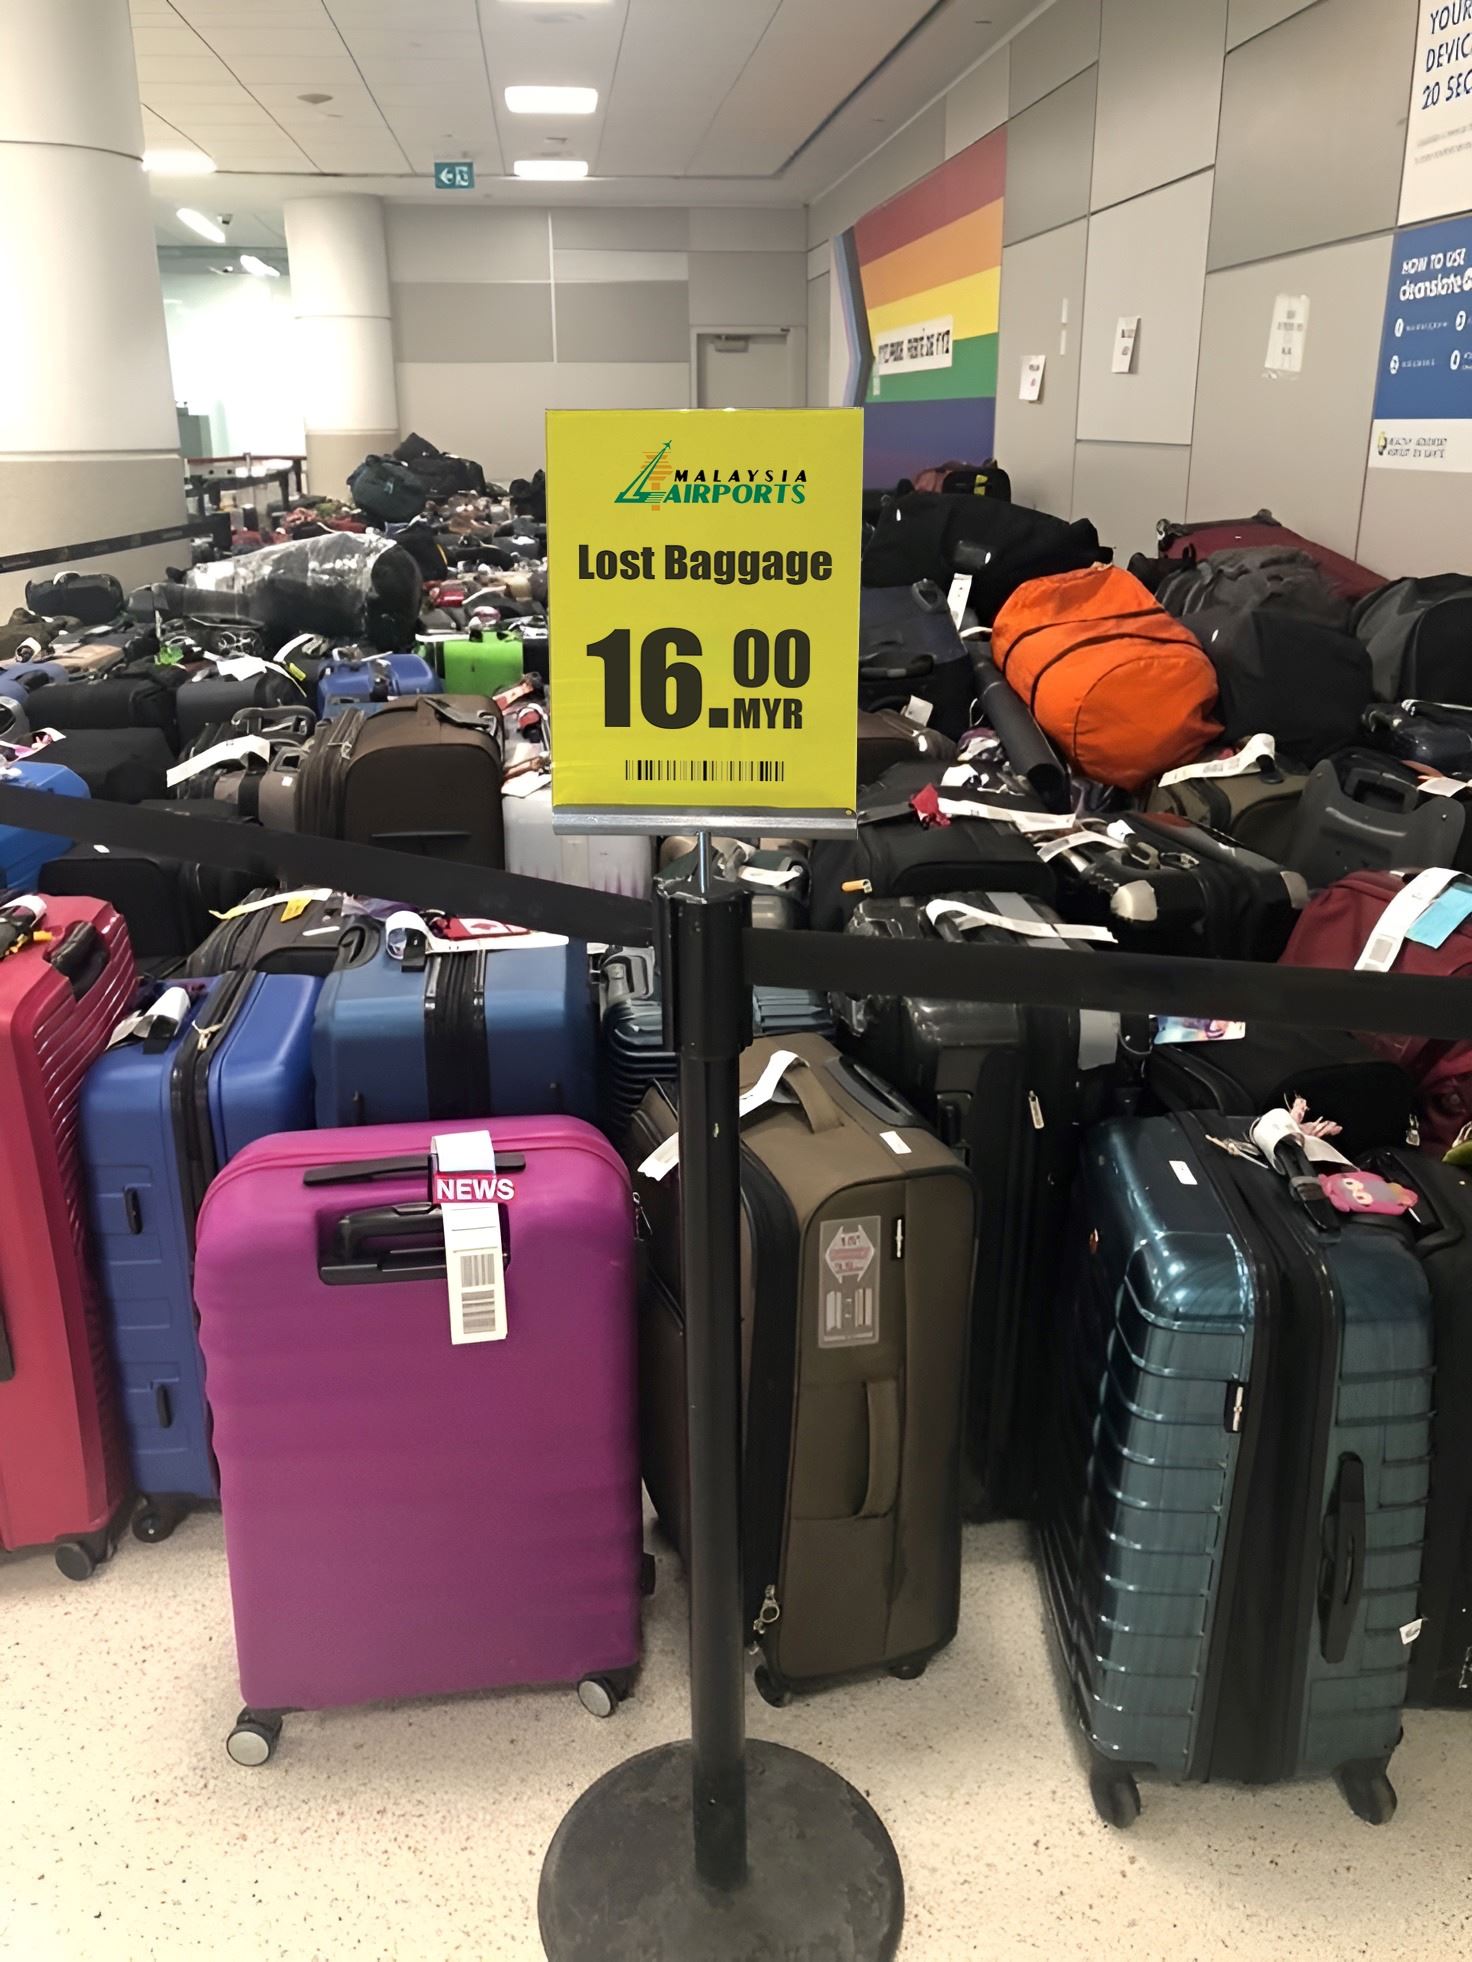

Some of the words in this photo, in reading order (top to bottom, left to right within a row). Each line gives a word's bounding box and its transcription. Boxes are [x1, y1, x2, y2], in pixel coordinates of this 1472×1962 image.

[1430, 0, 1472, 35] YOUR
[1422, 81, 1441, 110] 20
[1430, 252, 1444, 270] TO
[674, 469, 807, 483] MALAYSIA
[662, 483, 807, 504] AIRPORTS
[578, 544, 656, 580] Lost
[664, 544, 832, 585] Baggage
[733, 628, 811, 689] 00
[733, 698, 803, 729] MYR
